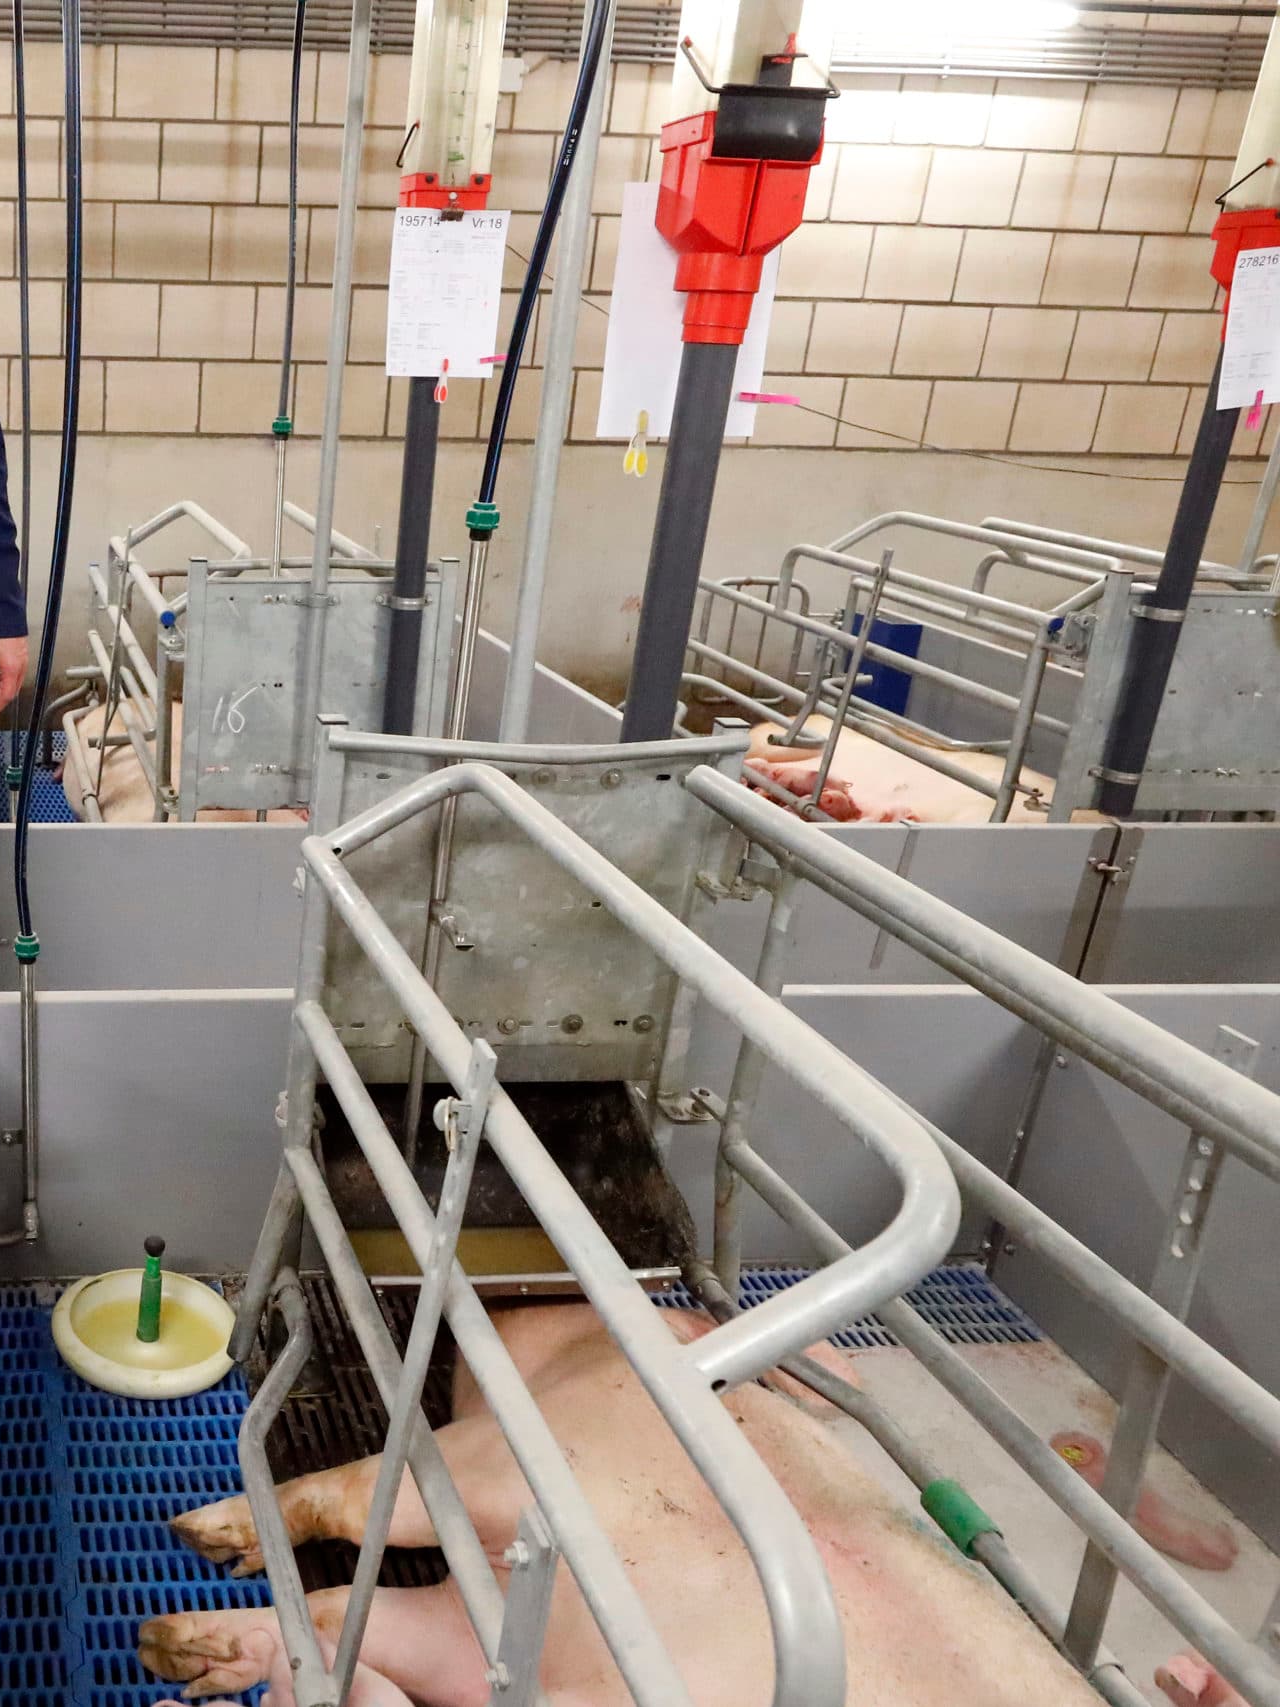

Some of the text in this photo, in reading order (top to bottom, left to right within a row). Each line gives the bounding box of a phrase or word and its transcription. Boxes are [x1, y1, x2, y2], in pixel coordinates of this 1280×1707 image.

[399, 215, 502, 229] 195714 Vr 18
[1238, 253, 1279, 268] 278216
